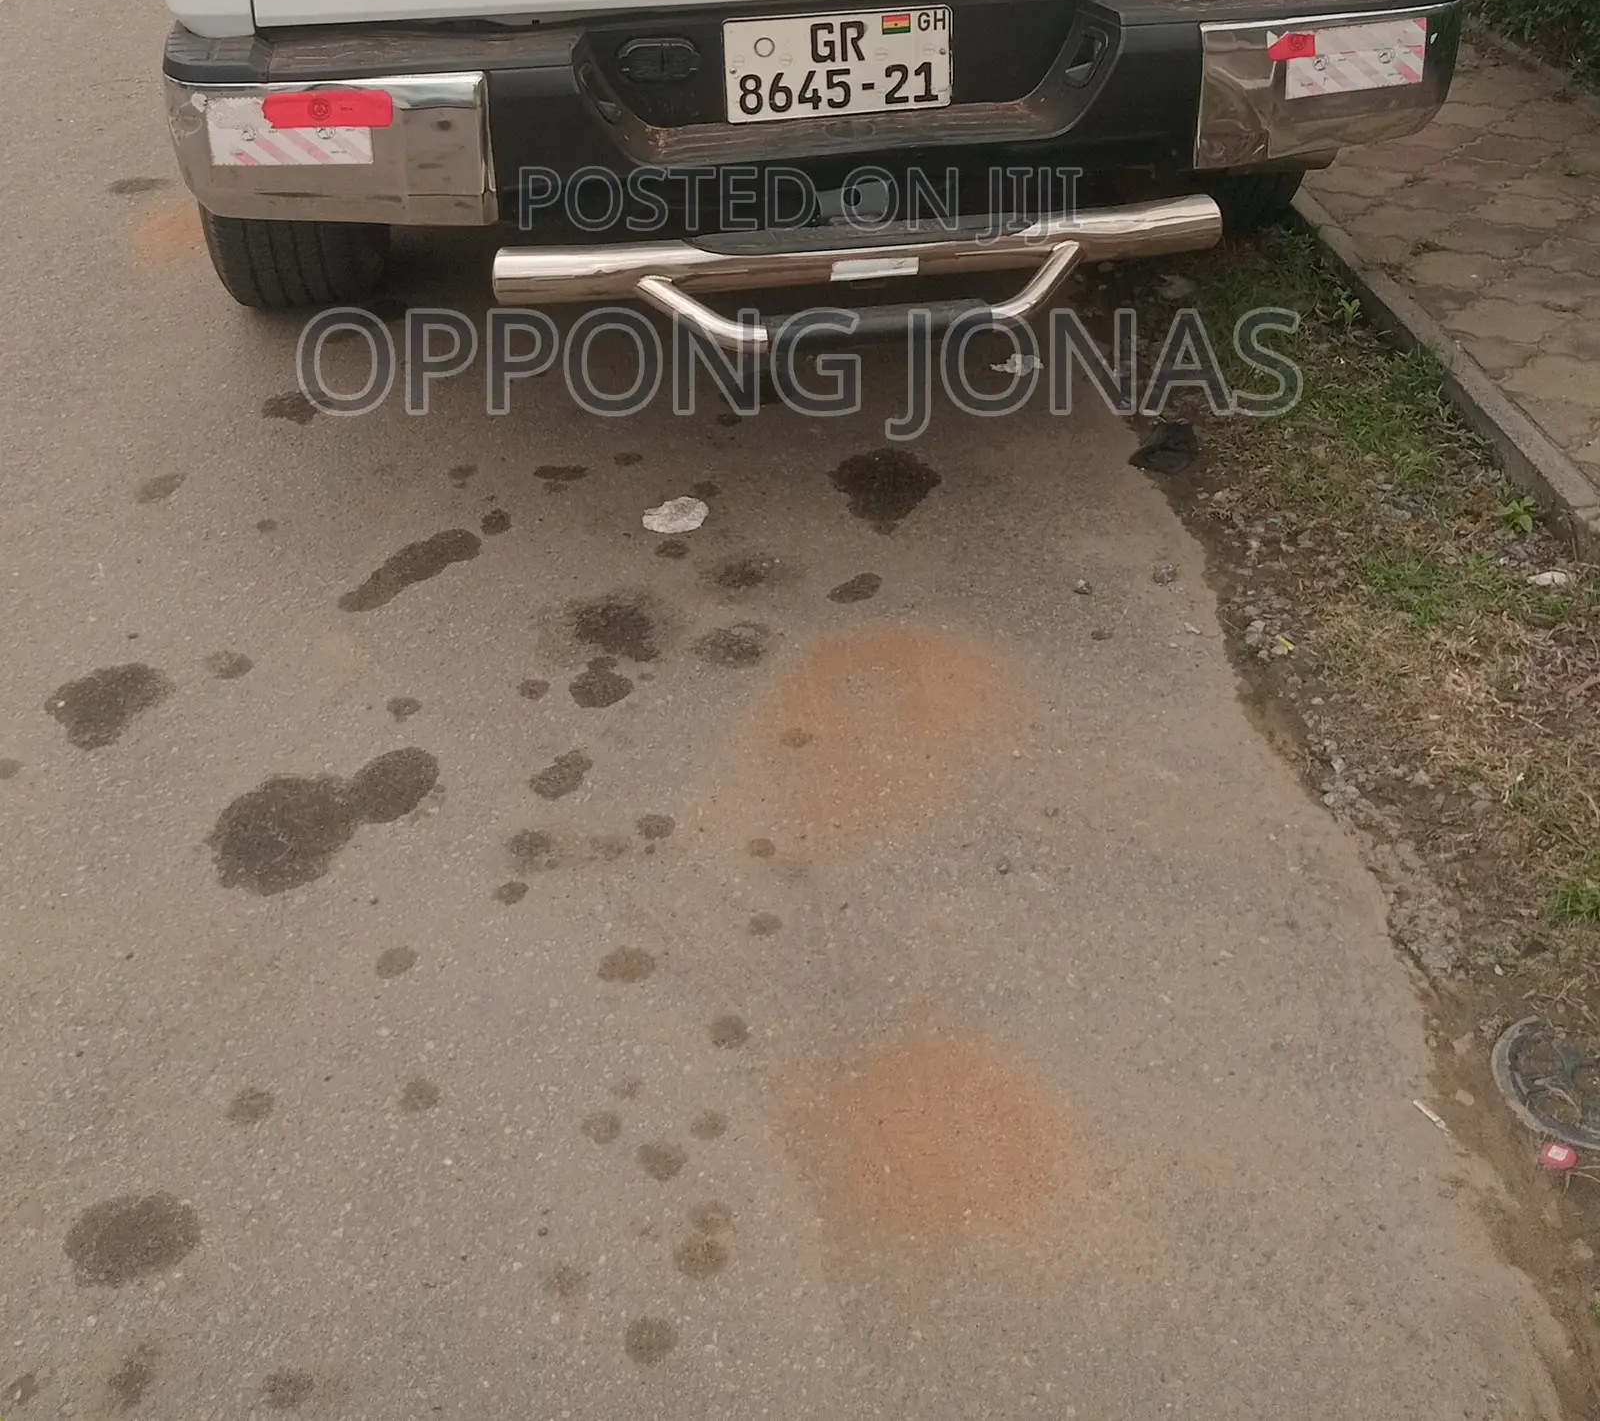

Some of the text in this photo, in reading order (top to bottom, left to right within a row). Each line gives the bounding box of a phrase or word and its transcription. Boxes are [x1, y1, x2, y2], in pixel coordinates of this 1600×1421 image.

[810, 9, 947, 63] GR GH
[739, 61, 939, 115] 8645-21
